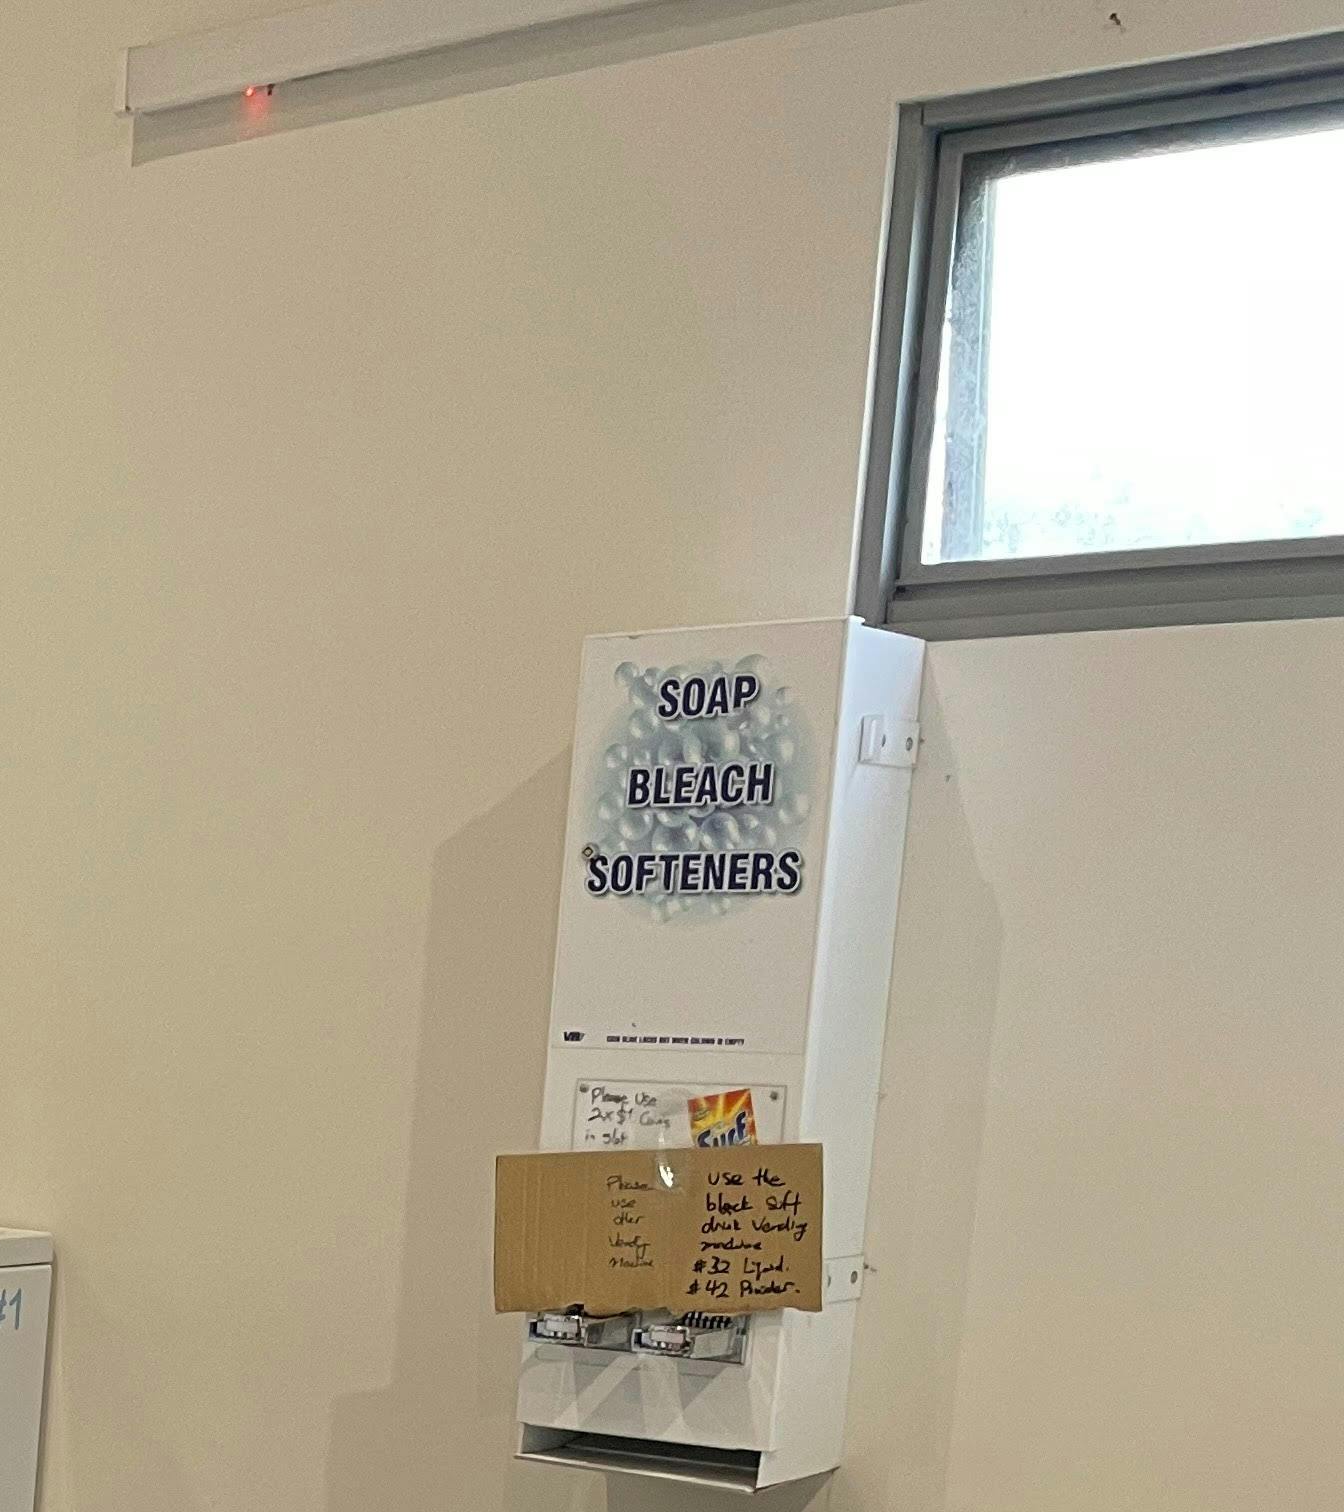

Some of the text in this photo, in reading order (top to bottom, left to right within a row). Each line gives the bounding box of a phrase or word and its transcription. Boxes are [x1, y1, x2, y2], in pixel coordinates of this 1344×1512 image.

[659, 676, 759, 719] SOAP
[628, 764, 773, 810] BLEACH
[587, 852, 801, 896] SOFTENERS
